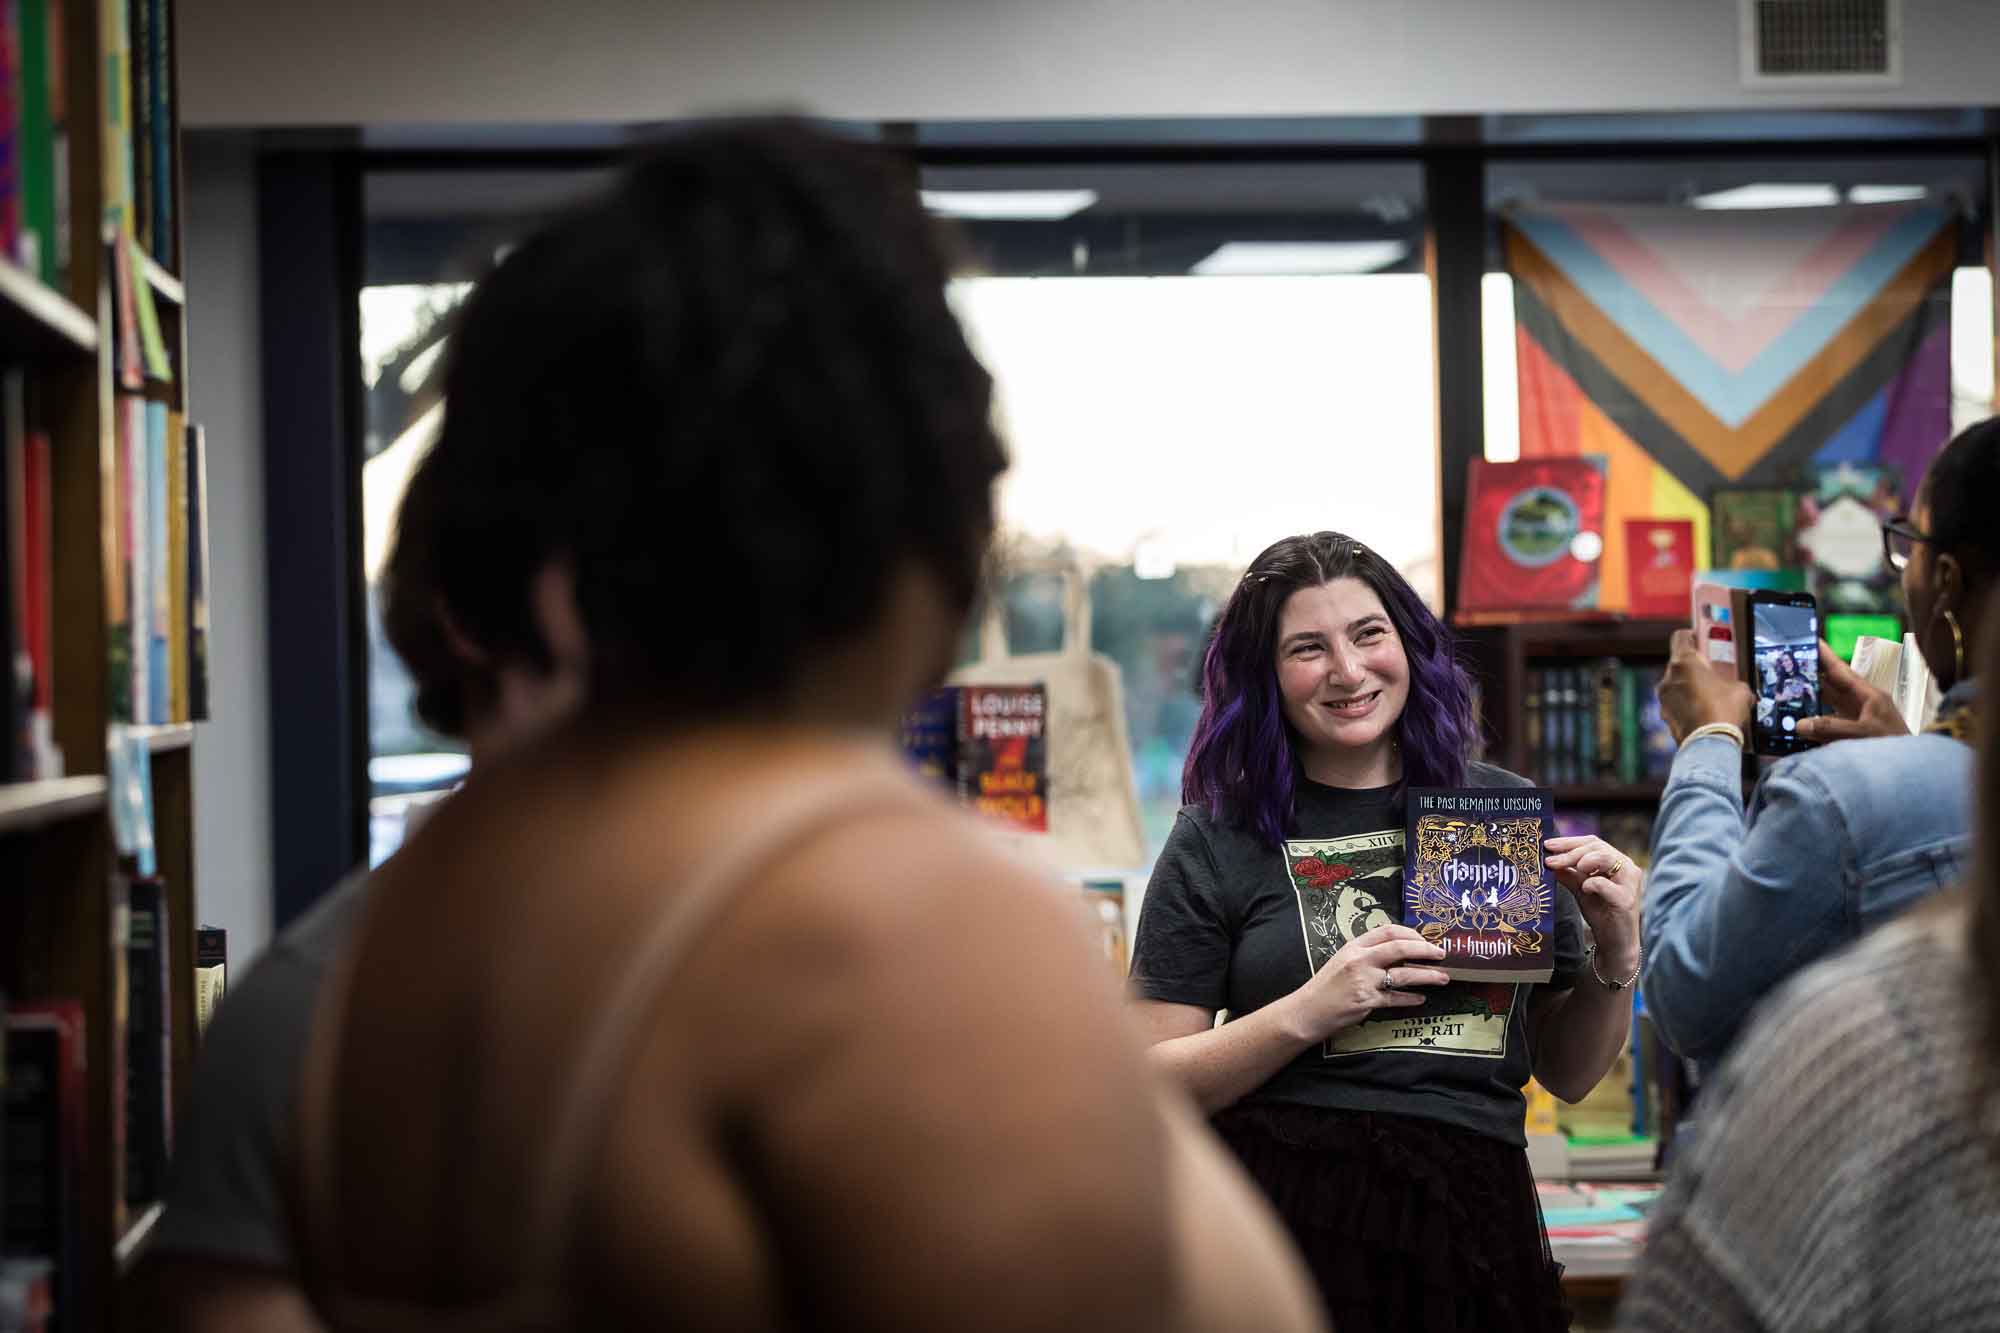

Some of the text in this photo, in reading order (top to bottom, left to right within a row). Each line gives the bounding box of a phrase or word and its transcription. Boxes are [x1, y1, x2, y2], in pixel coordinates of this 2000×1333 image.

[1419, 796, 1542, 812] THE PAST REMAINS UNSUNG
[1391, 1023, 1464, 1039] THE RAT
